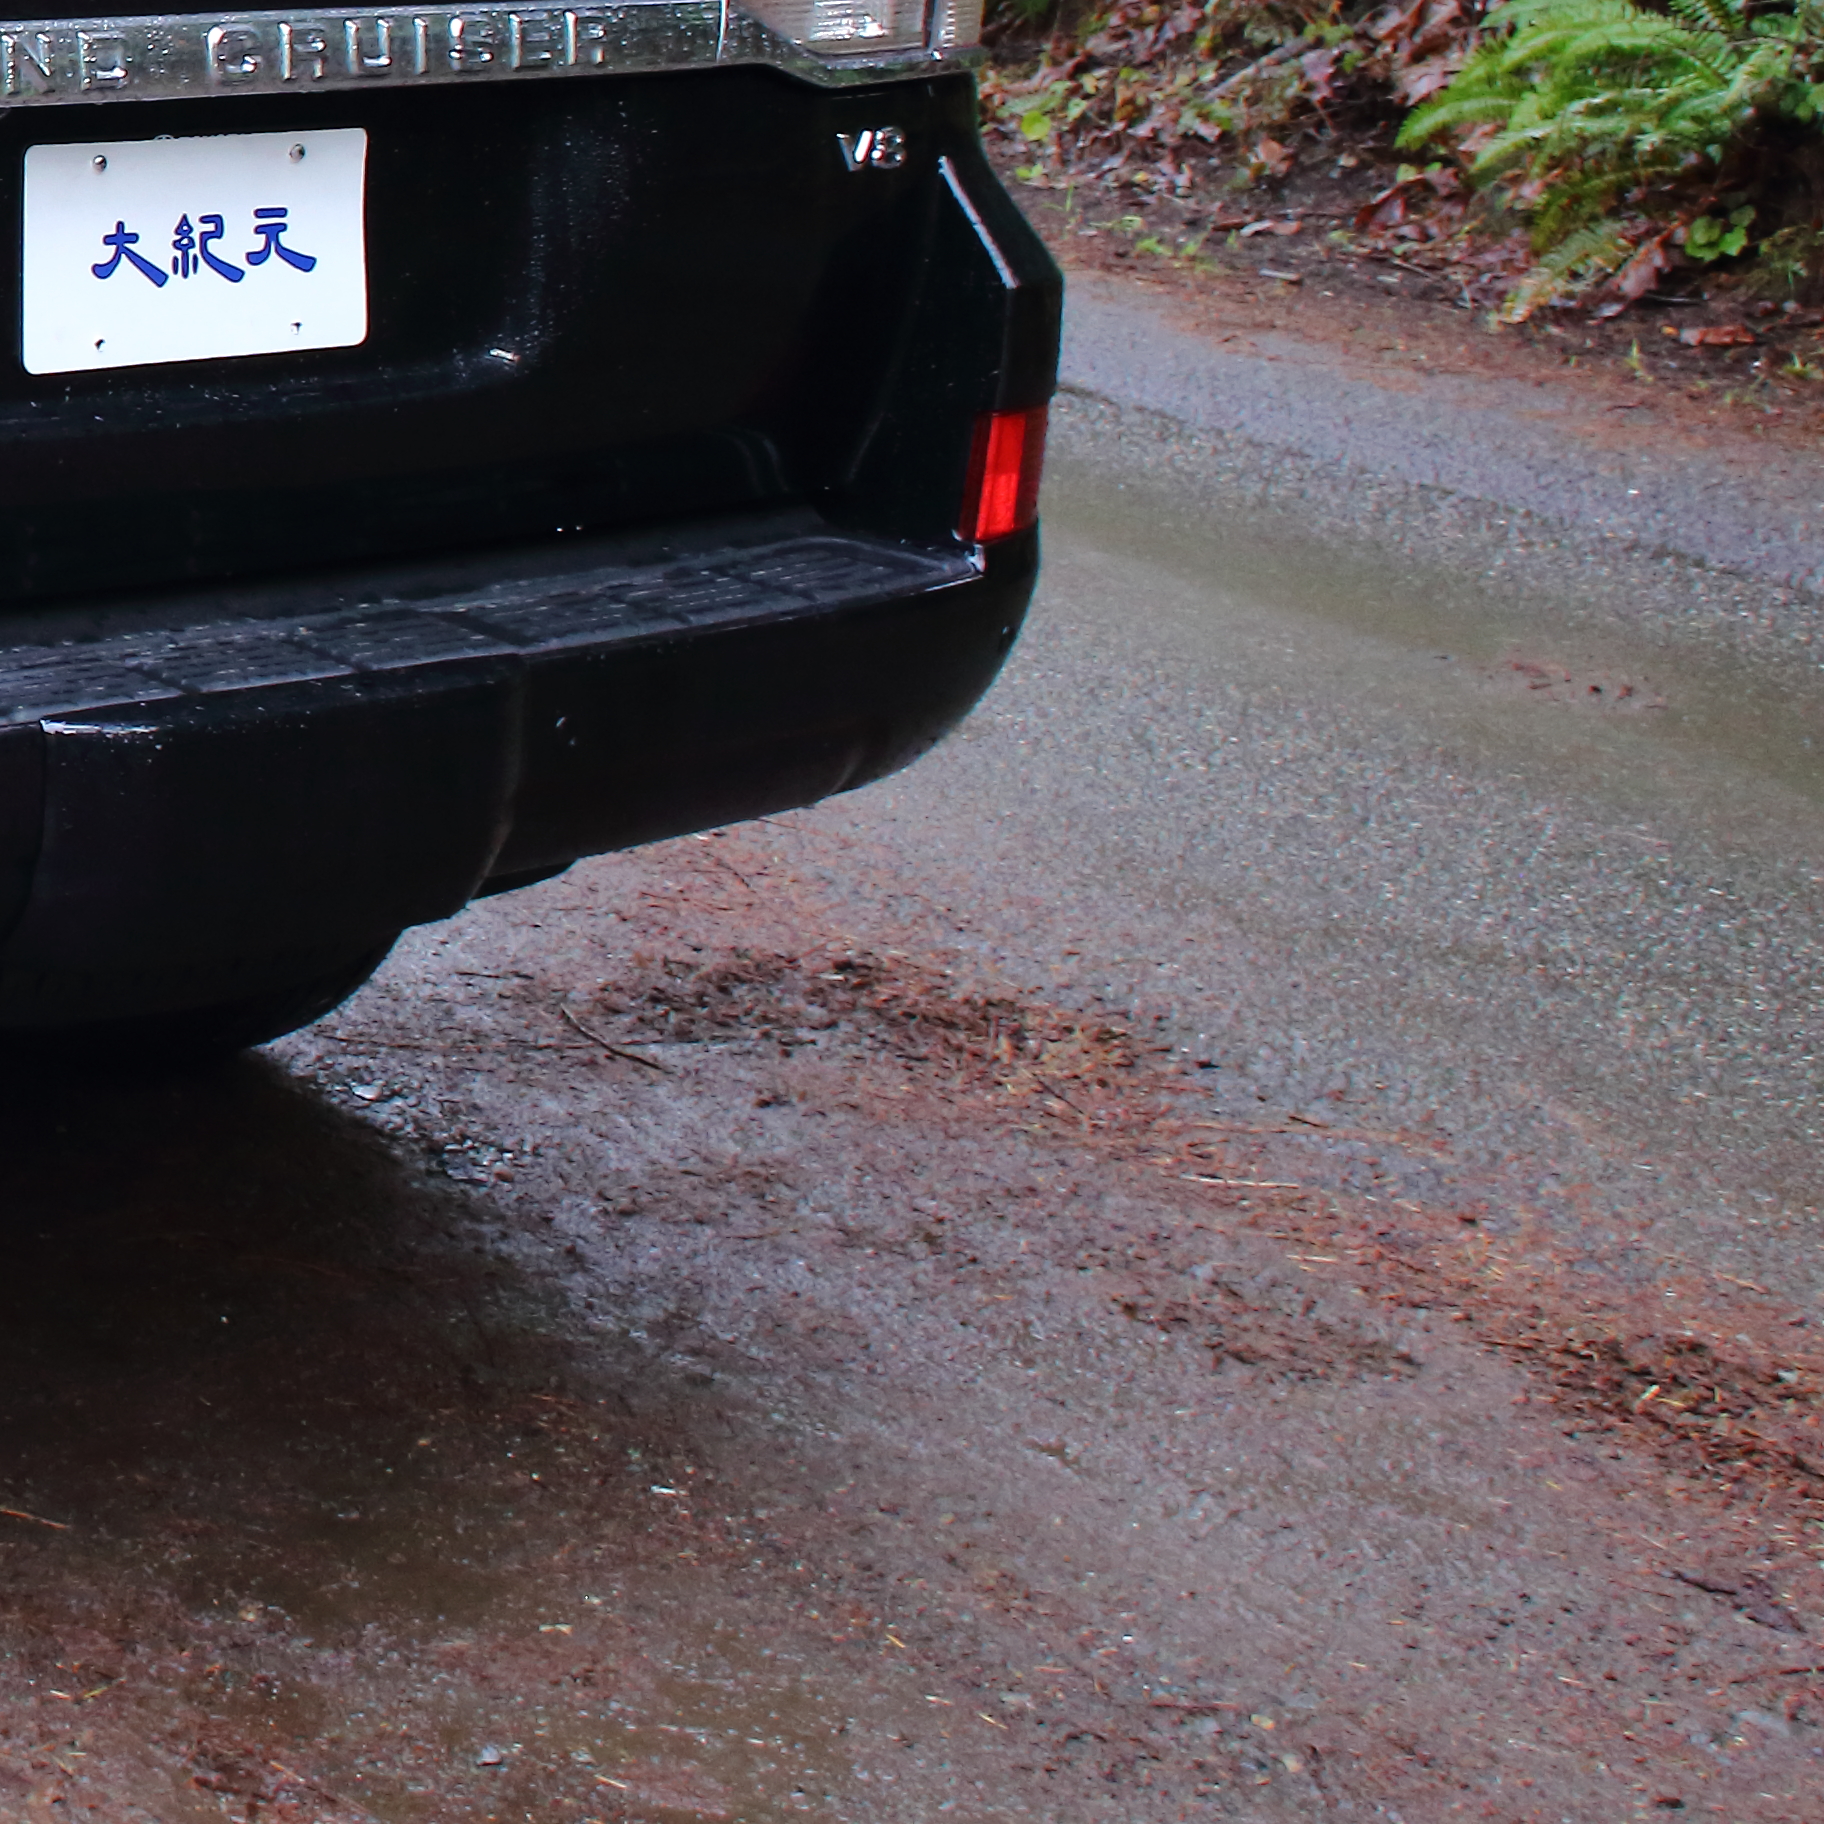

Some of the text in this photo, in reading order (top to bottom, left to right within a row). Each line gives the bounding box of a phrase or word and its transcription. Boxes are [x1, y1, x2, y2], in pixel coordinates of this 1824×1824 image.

[204, 8, 608, 83] CRUISER
[835, 125, 908, 172] V8
[90, 206, 318, 289] 大紀元
